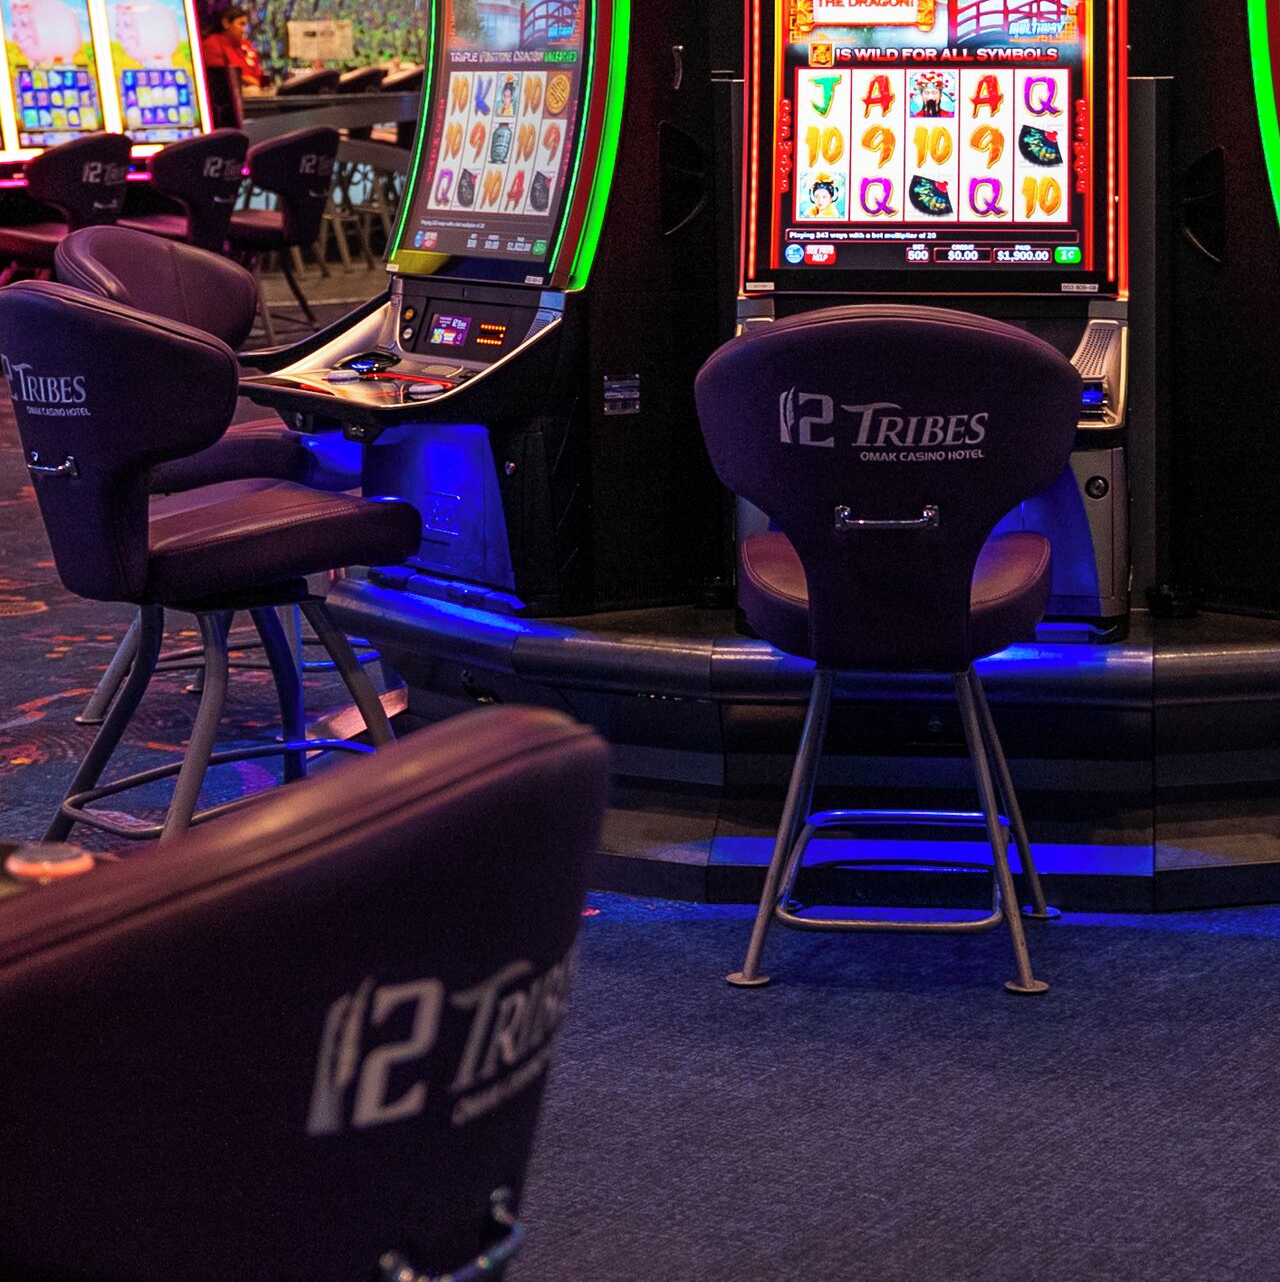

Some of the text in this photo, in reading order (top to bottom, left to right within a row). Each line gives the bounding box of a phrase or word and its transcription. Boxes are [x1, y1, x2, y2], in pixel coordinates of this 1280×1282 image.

[835, 48, 1059, 62] IS WILD FOR ALL SYMBOLS
[475, 74, 492, 116] K
[811, 73, 1064, 119] J A A Q
[469, 121, 486, 163] 9
[543, 121, 561, 166] 9
[805, 123, 1005, 169] 10 9 10 9
[82, 162, 102, 183] 12
[203, 157, 222, 178] 12
[505, 169, 525, 211] A
[858, 175, 1062, 218] Q Q 10
[789, 231, 816, 239] Playing
[907, 250, 929, 260] 500
[948, 250, 979, 261] $0.00
[996, 250, 1050, 261] $1,900.00
[11, 363, 87, 403] TRIBES
[779, 386, 989, 448] 12 TRIBES
[860, 449, 985, 462] OMAK CASINO HOTEL
[305, 975, 445, 1138] 12
